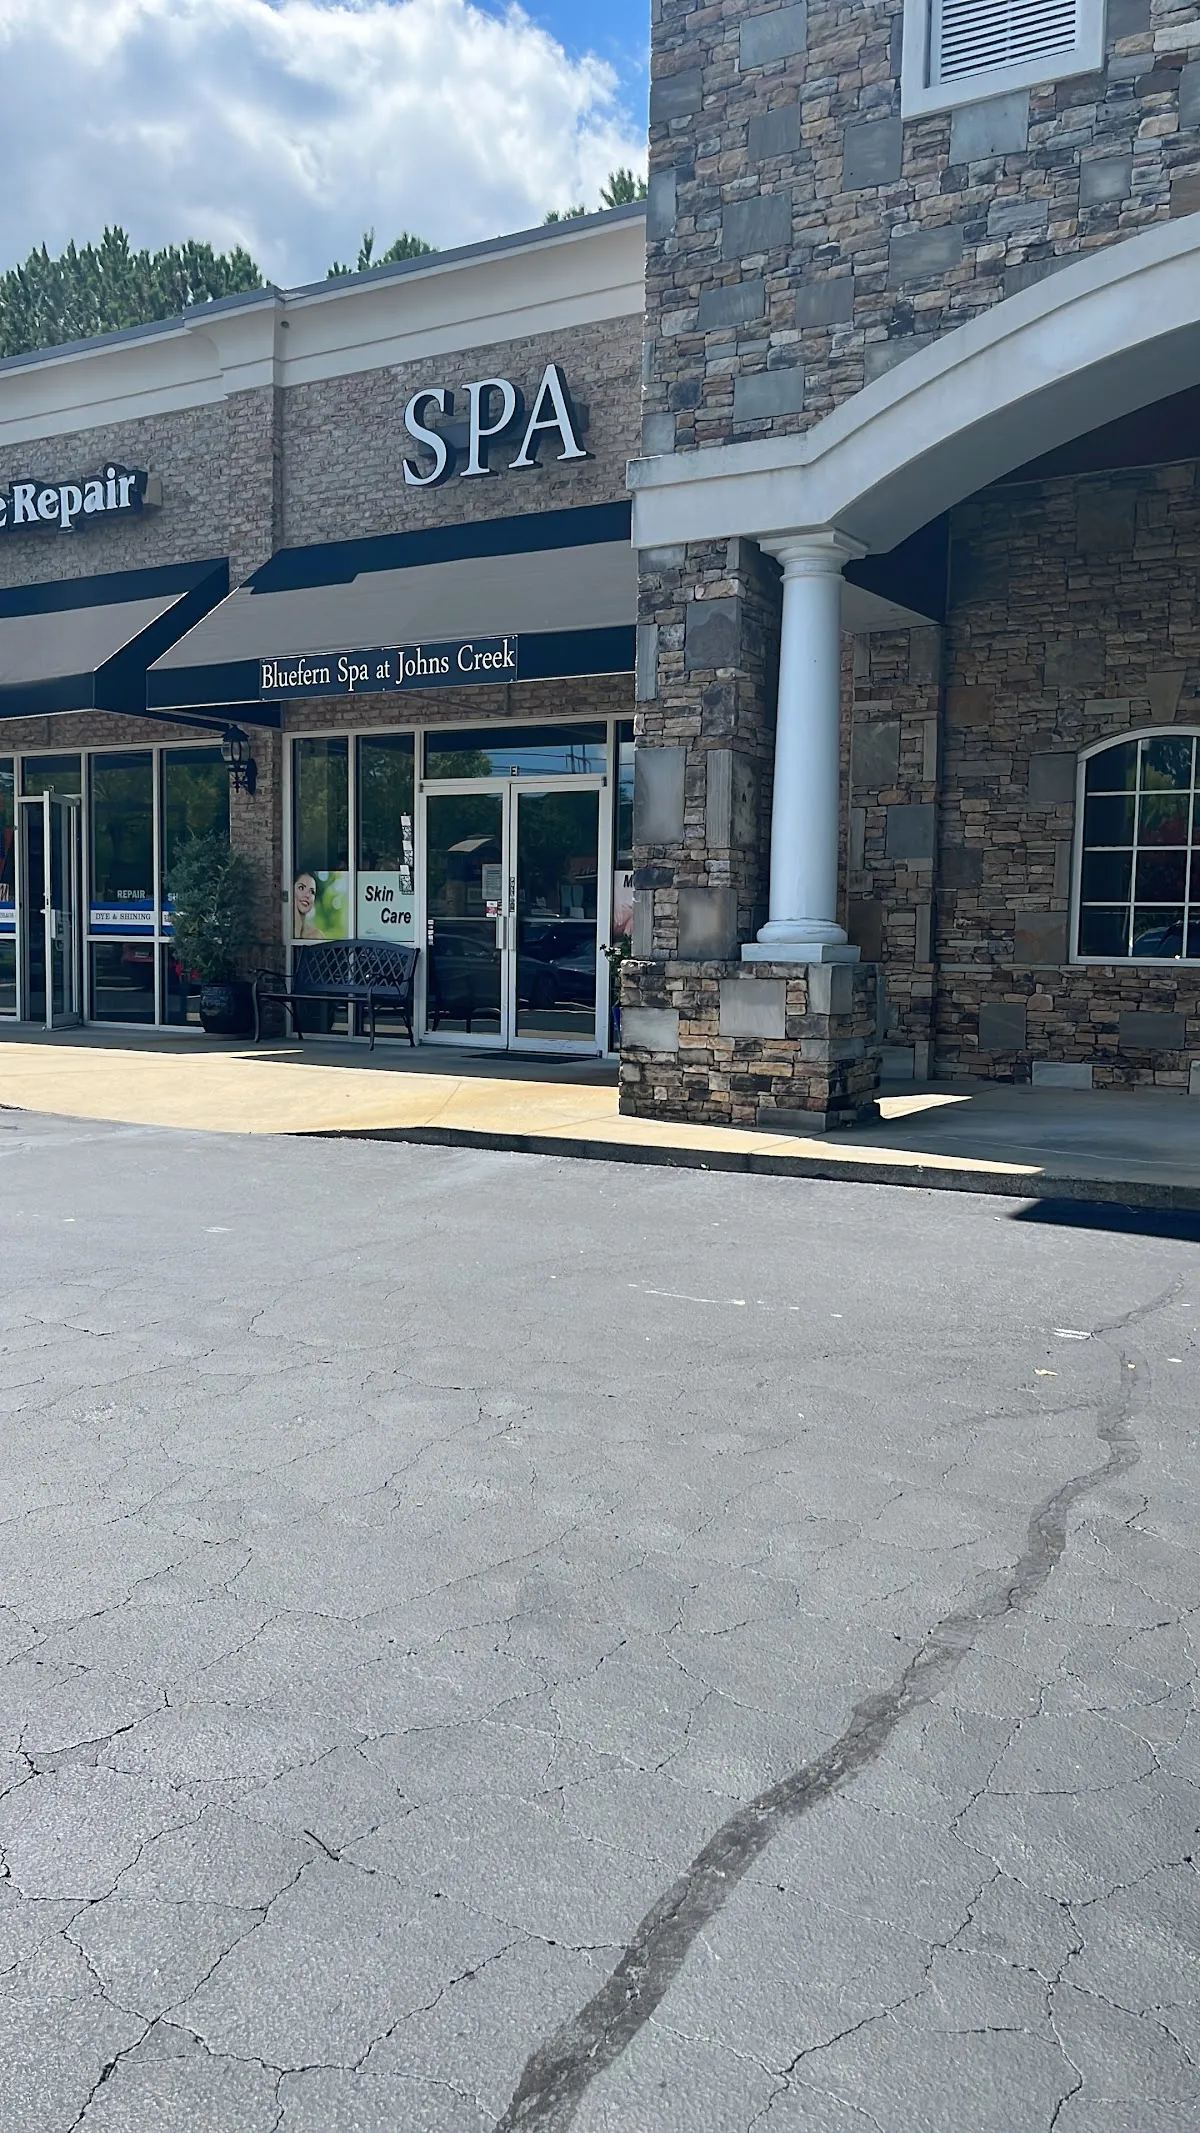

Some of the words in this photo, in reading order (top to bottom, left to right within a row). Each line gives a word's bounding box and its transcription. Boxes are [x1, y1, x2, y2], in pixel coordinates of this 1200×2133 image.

[402, 363, 588, 486] SPA
[12, 467, 136, 528] Repair
[261, 659, 330, 689] Bluefern
[337, 656, 369, 691] Spa
[376, 660, 390, 679] at
[396, 648, 449, 684] Johns
[457, 639, 515, 671] Creek
[117, 889, 146, 899] REPAIR
[365, 885, 394, 902] Skin
[95, 912, 111, 920] DYE
[120, 912, 151, 920] SHINING
[380, 907, 412, 924] Care
